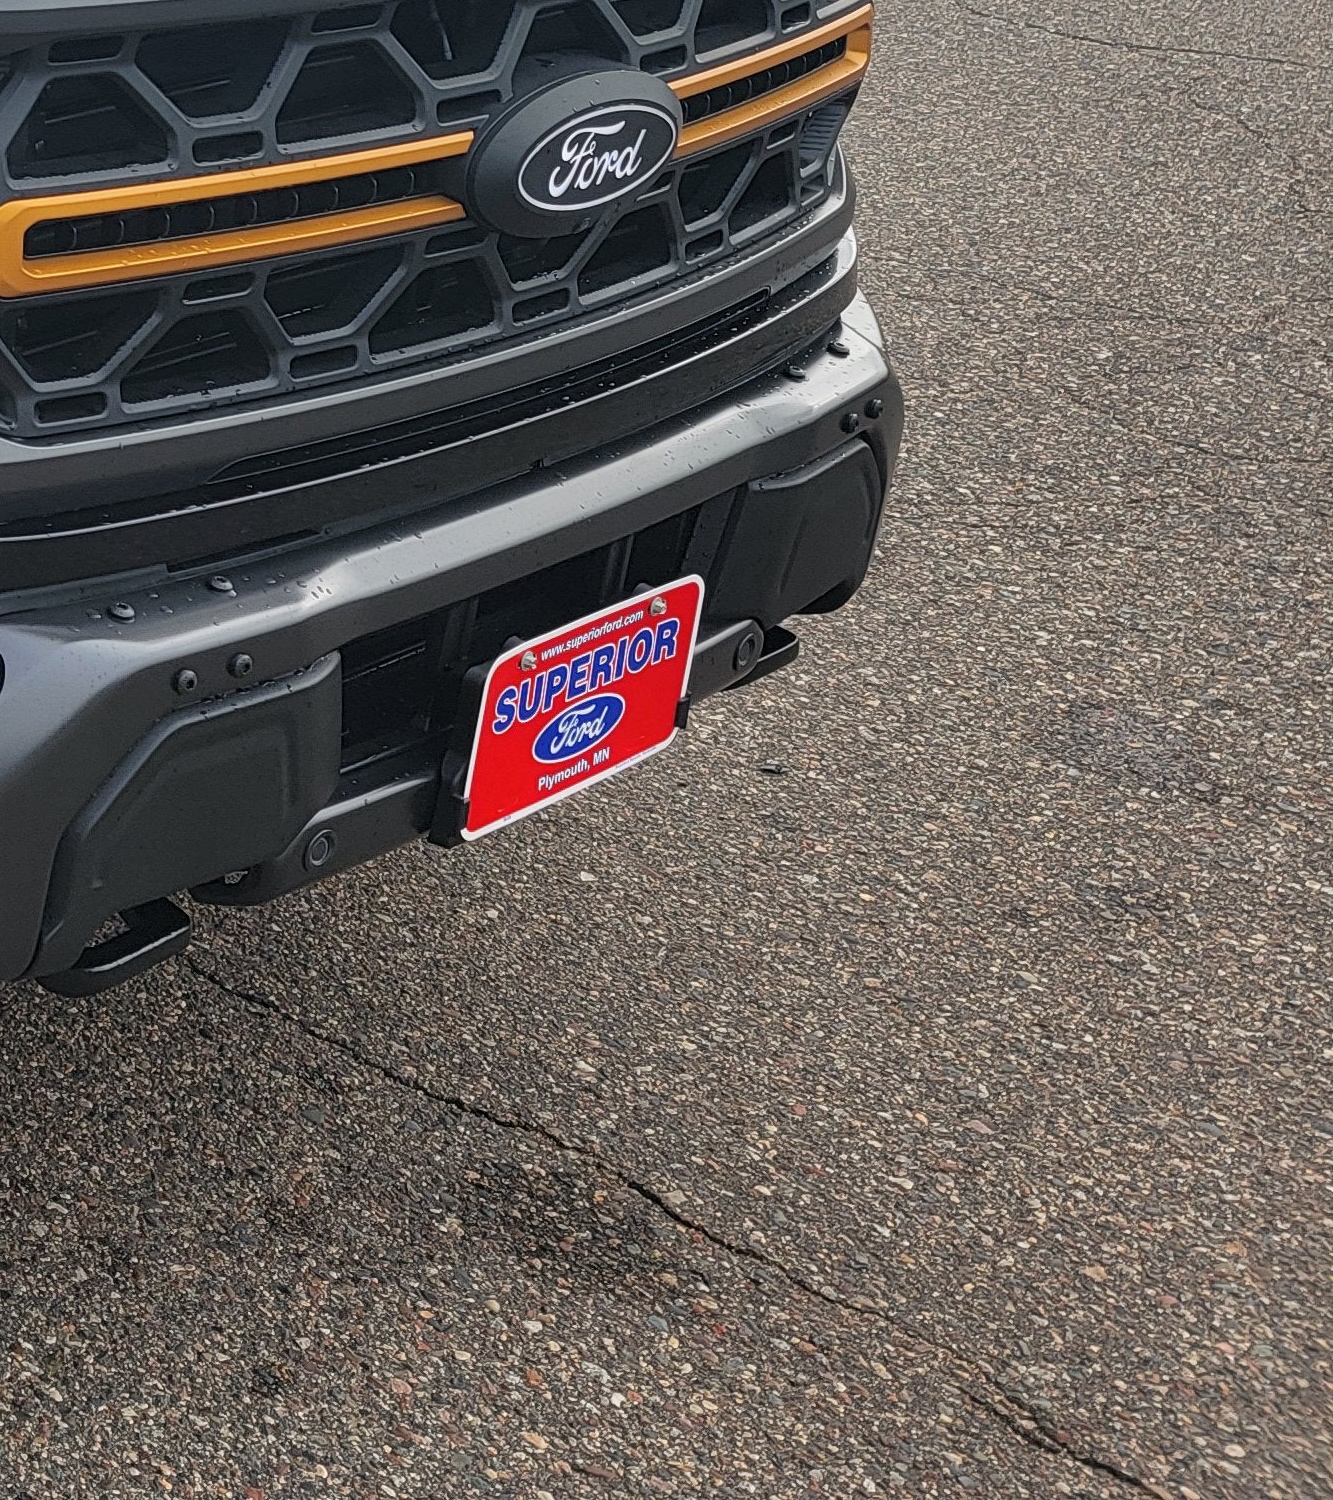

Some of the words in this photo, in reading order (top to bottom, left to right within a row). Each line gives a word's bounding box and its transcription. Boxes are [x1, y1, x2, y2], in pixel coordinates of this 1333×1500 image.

[548, 120, 647, 198] Ford
[540, 609, 644, 662] www.superiorford.com
[492, 617, 680, 735] SUPERIOR
[550, 704, 609, 754] Ford
[537, 758, 591, 792] Plymouth,
[592, 746, 611, 767] MN
